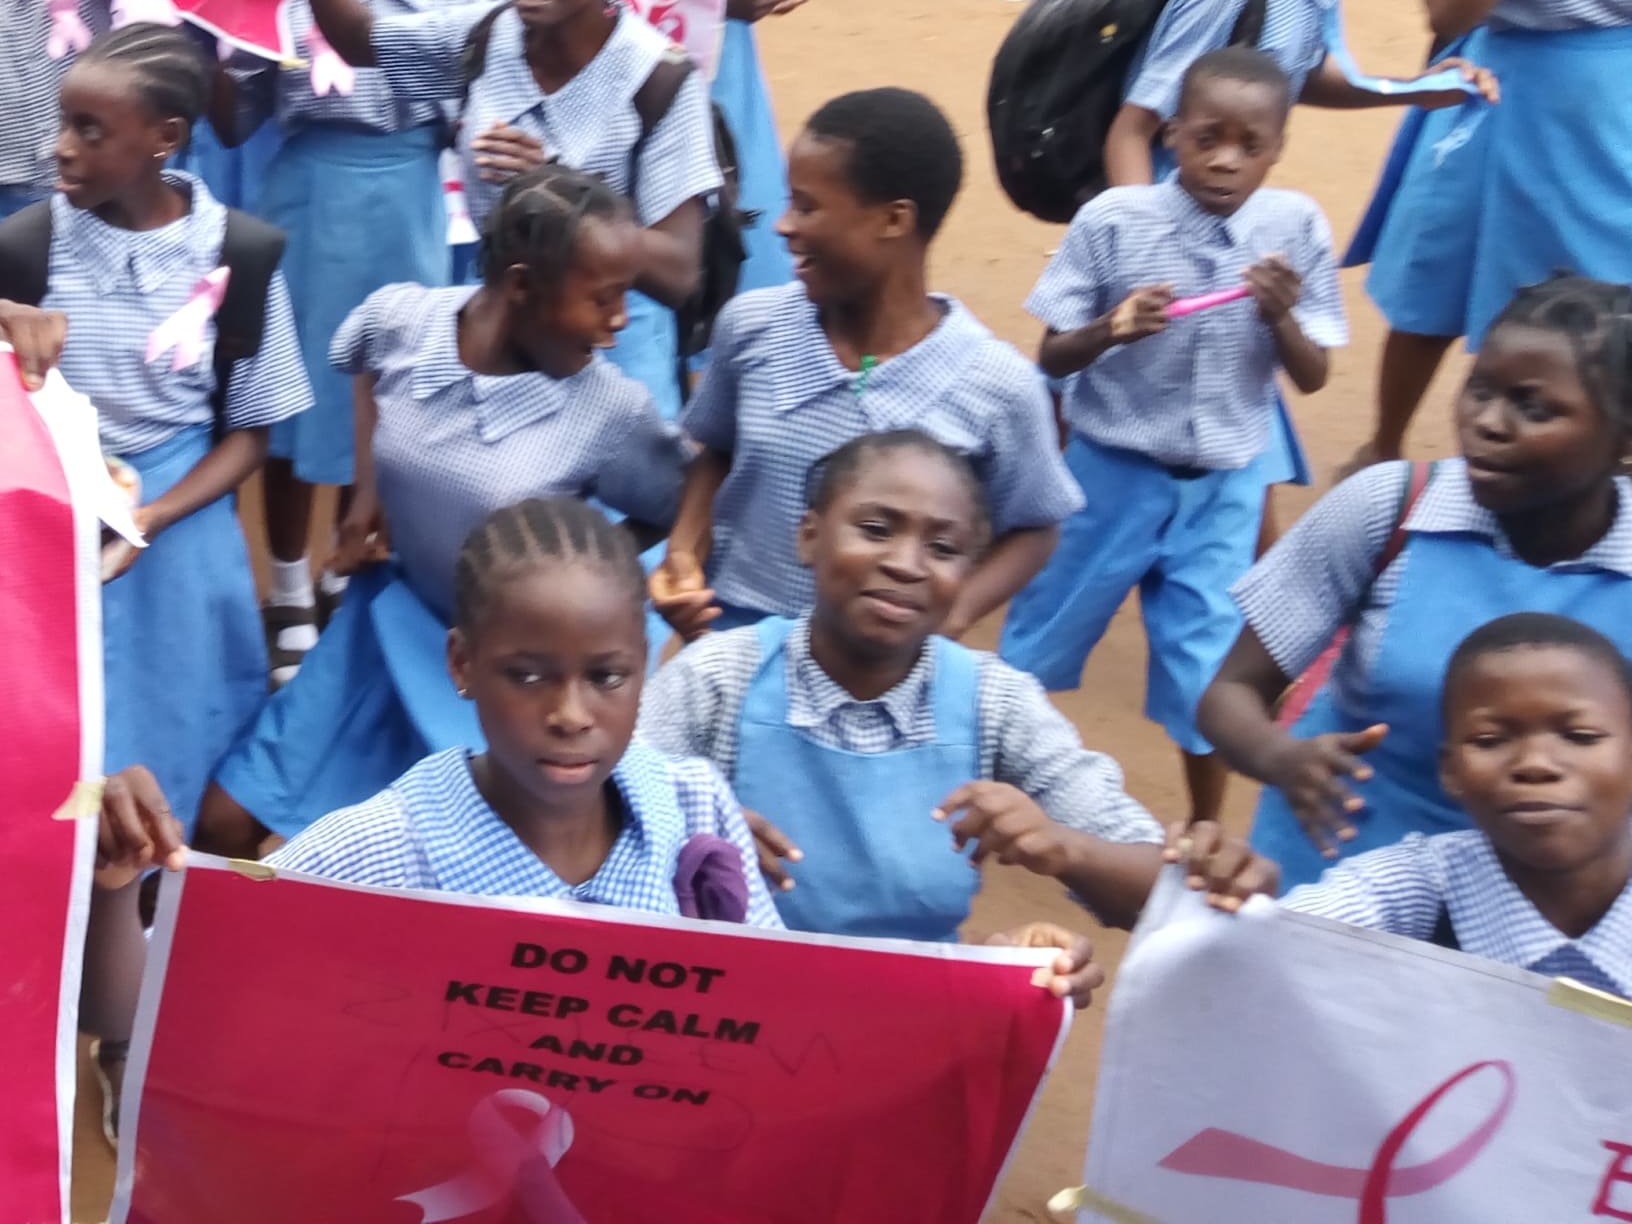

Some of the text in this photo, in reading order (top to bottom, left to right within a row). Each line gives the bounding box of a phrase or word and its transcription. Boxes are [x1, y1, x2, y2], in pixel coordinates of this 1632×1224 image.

[510, 941, 726, 994] DO NOT
[443, 980, 590, 1019] KEEP
[607, 1003, 761, 1044] CALM
[528, 1034, 644, 1067] AND
[437, 1051, 711, 1107] CARRY ON
